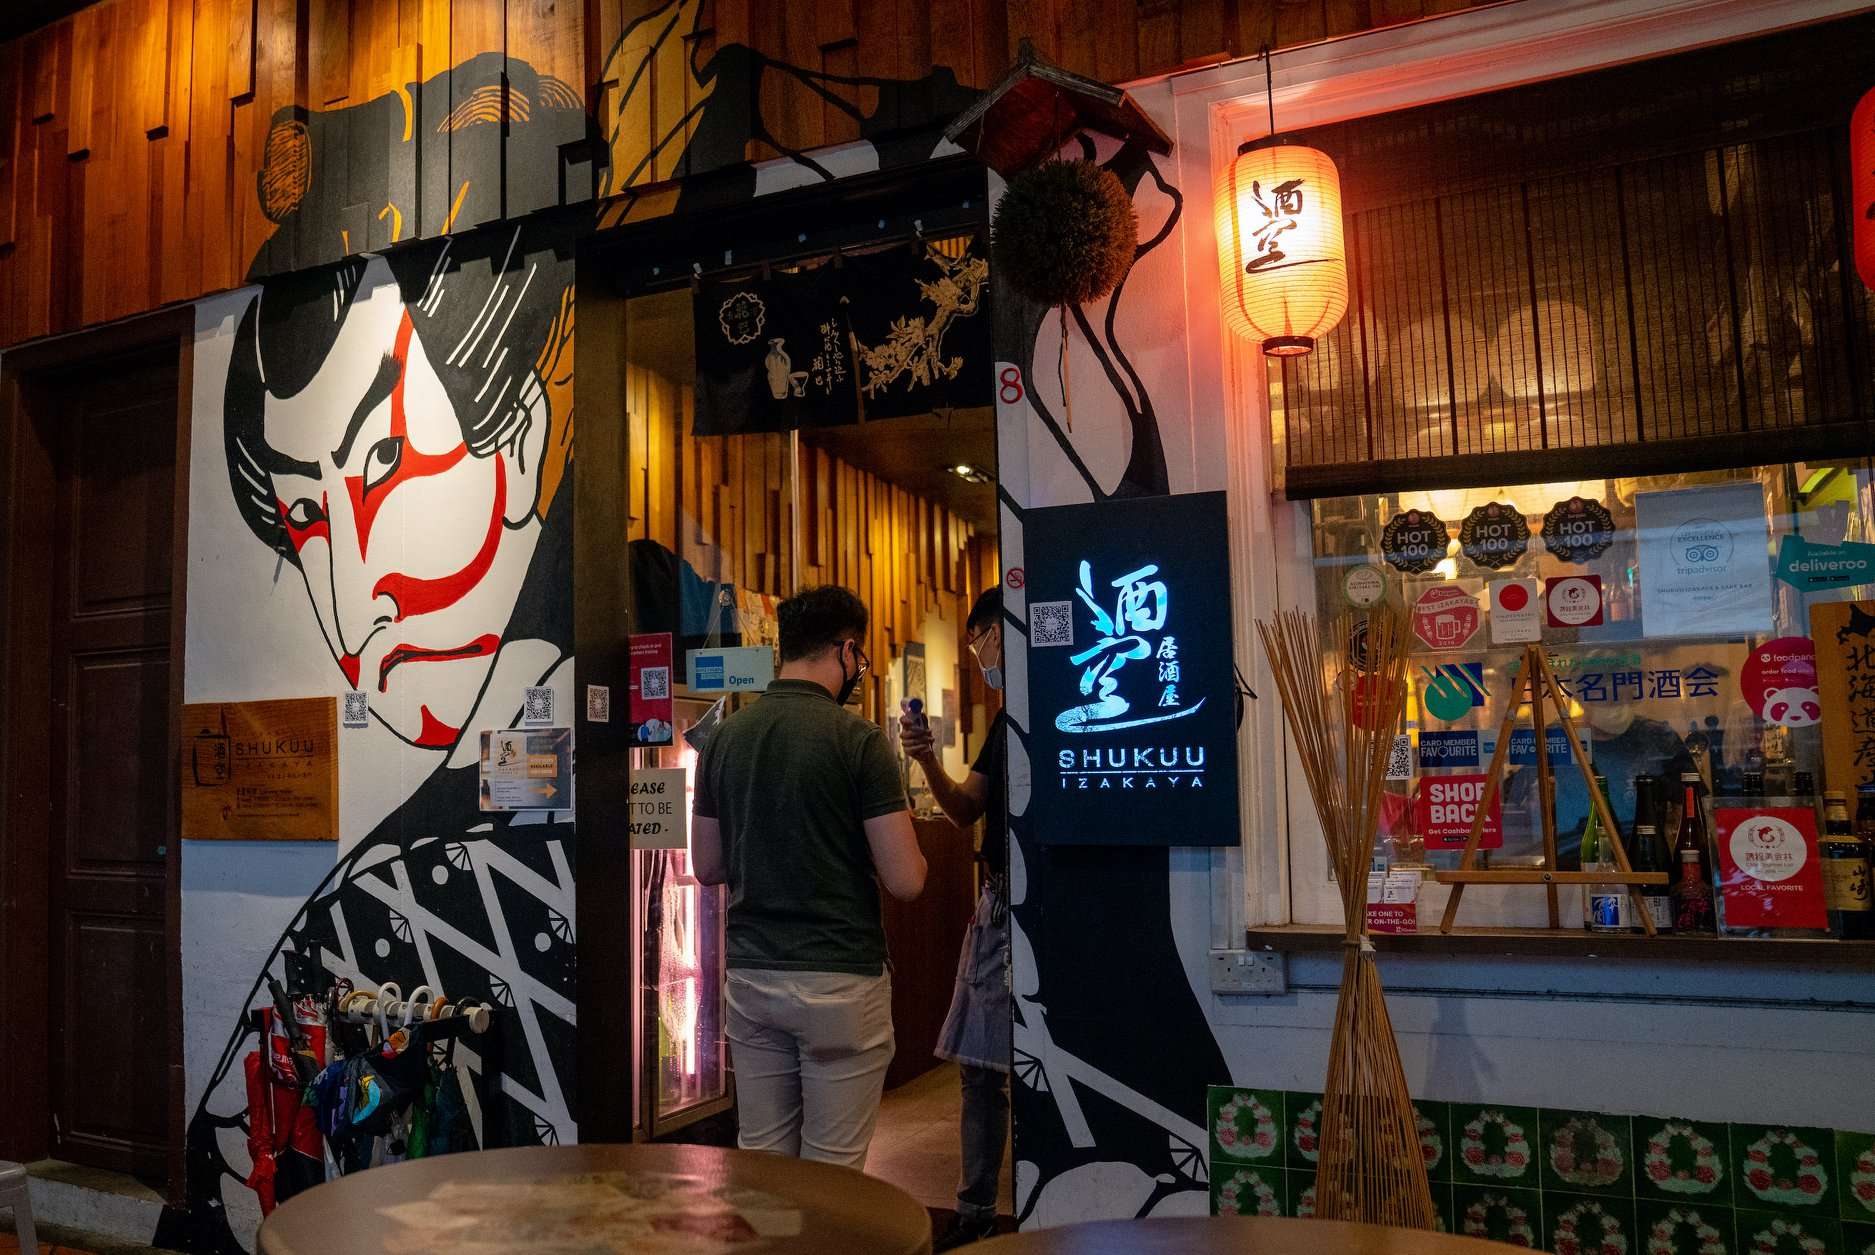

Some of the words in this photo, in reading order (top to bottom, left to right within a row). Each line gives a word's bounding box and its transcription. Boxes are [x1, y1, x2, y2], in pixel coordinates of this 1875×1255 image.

[999, 367, 1024, 405] 8
[1476, 523, 1512, 537] HOT
[1560, 520, 1596, 534] HOT
[1397, 530, 1432, 545] HOT
[1479, 537, 1509, 551] 100
[1563, 533, 1593, 548] 100
[1400, 544, 1429, 557] 100
[1788, 558, 1868, 573] deliveroo
[1055, 560, 1206, 733] 酒空
[1156, 636, 1182, 707] 居酒屋
[729, 675, 755, 687] Open
[1420, 739, 1442, 747] CARD
[1443, 737, 1477, 746] MEMBER
[1511, 737, 1533, 745] CARD
[1533, 736, 1567, 745] MBER
[235, 740, 315, 756] SHUKUU
[1058, 746, 1206, 770] SHUKUU
[629, 782, 666, 795] EASE
[1061, 776, 1204, 789] IZAKAYA
[638, 802, 655, 815] TO
[658, 802, 673, 815] BE
[1442, 827, 1472, 835] Cashba
[1766, 884, 1804, 892] FAVORITE
